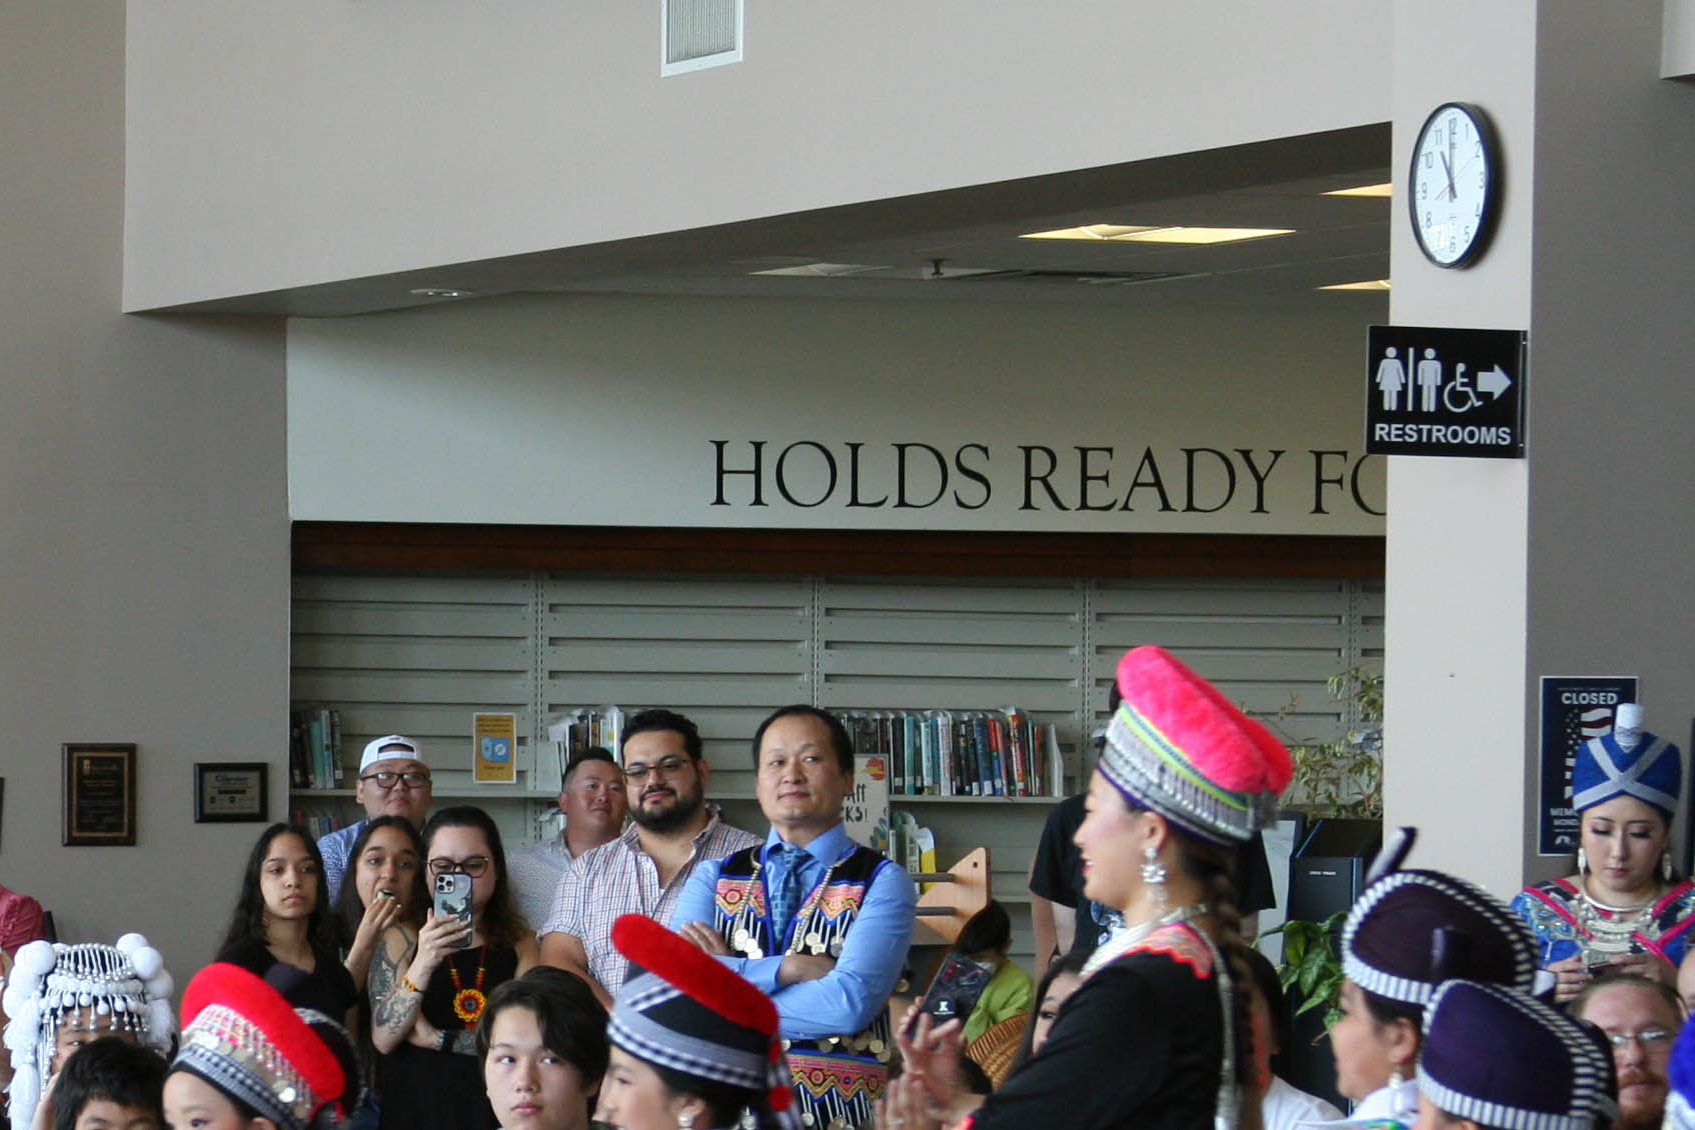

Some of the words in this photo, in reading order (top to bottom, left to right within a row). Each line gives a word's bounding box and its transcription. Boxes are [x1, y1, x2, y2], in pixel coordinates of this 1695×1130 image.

[1421, 182, 1428, 201] 9
[1374, 422, 1512, 446] RESTROOMS
[708, 440, 992, 510] HOLDS
[1017, 445, 1287, 514] READY
[1560, 691, 1619, 705] CLOSED
